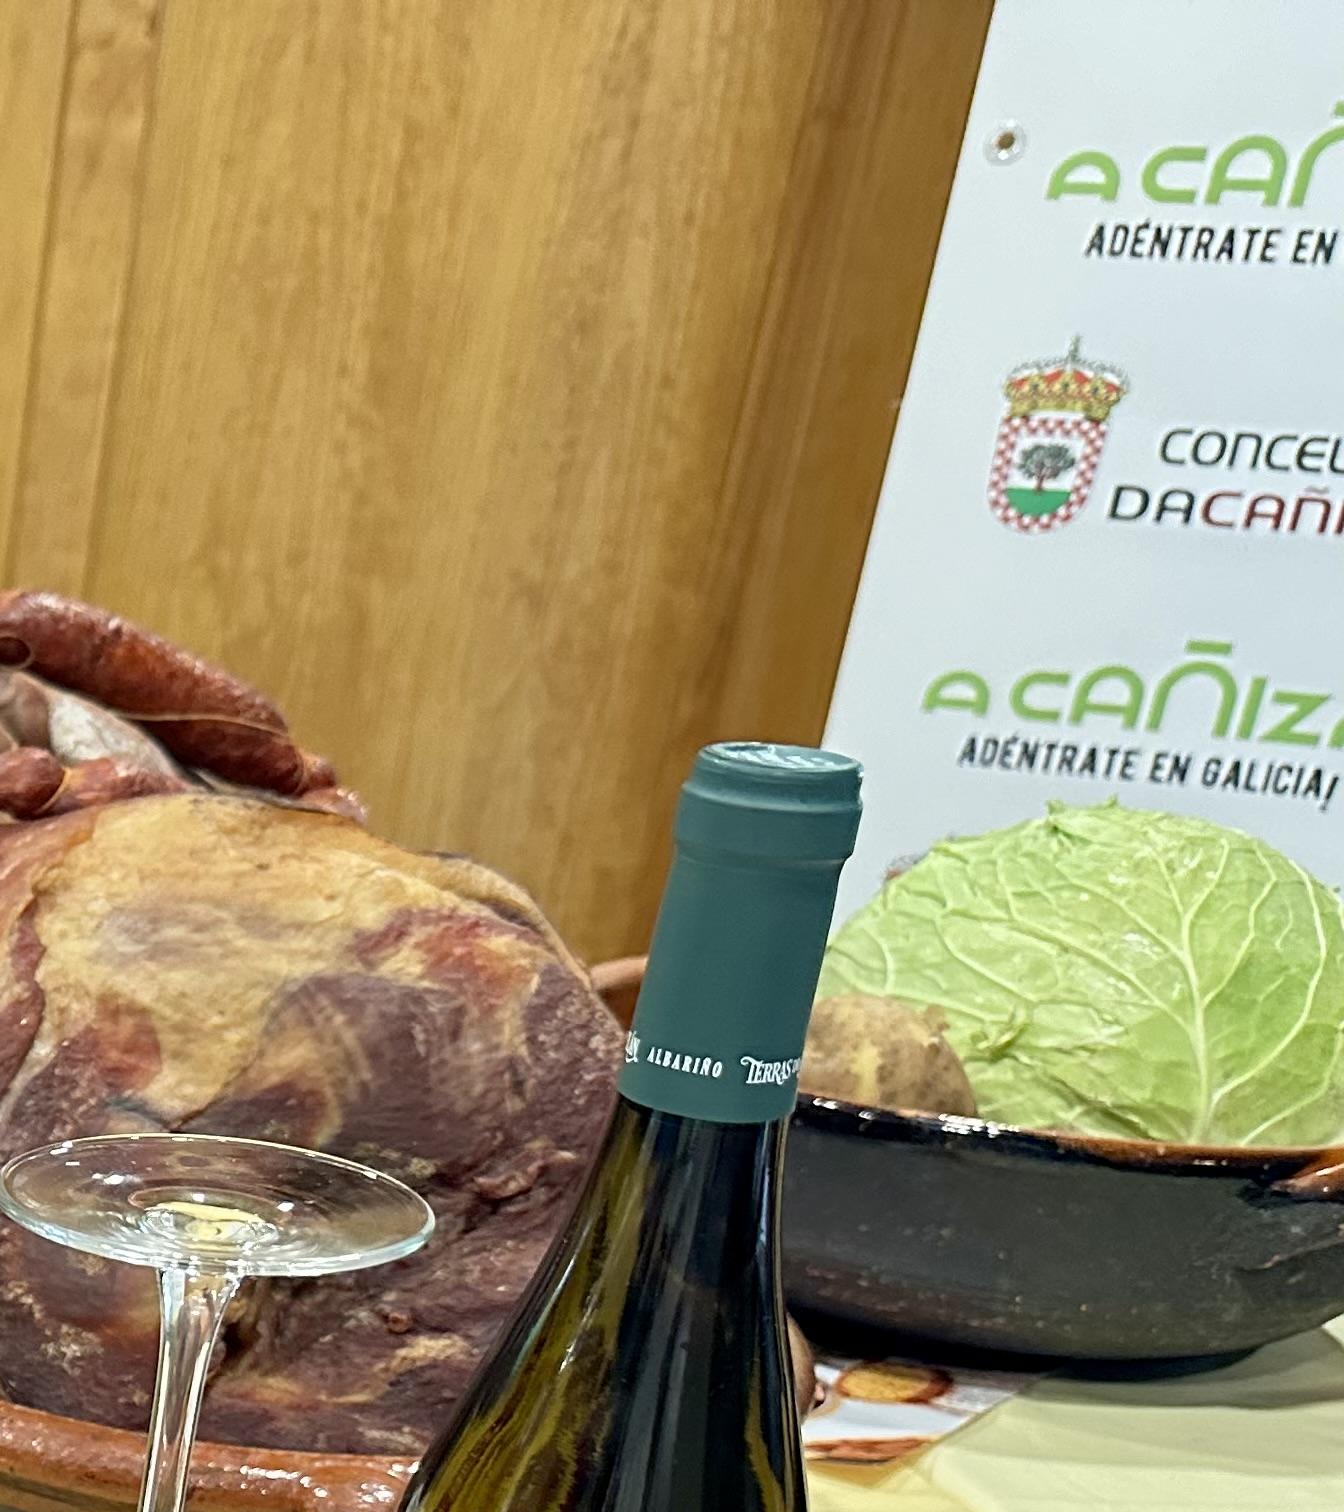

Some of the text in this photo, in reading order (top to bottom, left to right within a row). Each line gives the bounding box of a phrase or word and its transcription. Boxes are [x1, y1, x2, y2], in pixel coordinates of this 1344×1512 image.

[1046, 151, 1120, 201] A
[1084, 218, 1338, 265] ADÉNTRATE EN
[921, 640, 1344, 748] A CAÑIZ
[957, 732, 1131, 782] ADÉNTRATE
[1149, 753, 1191, 787] EN
[647, 1046, 723, 1078] ALBARIÑO
